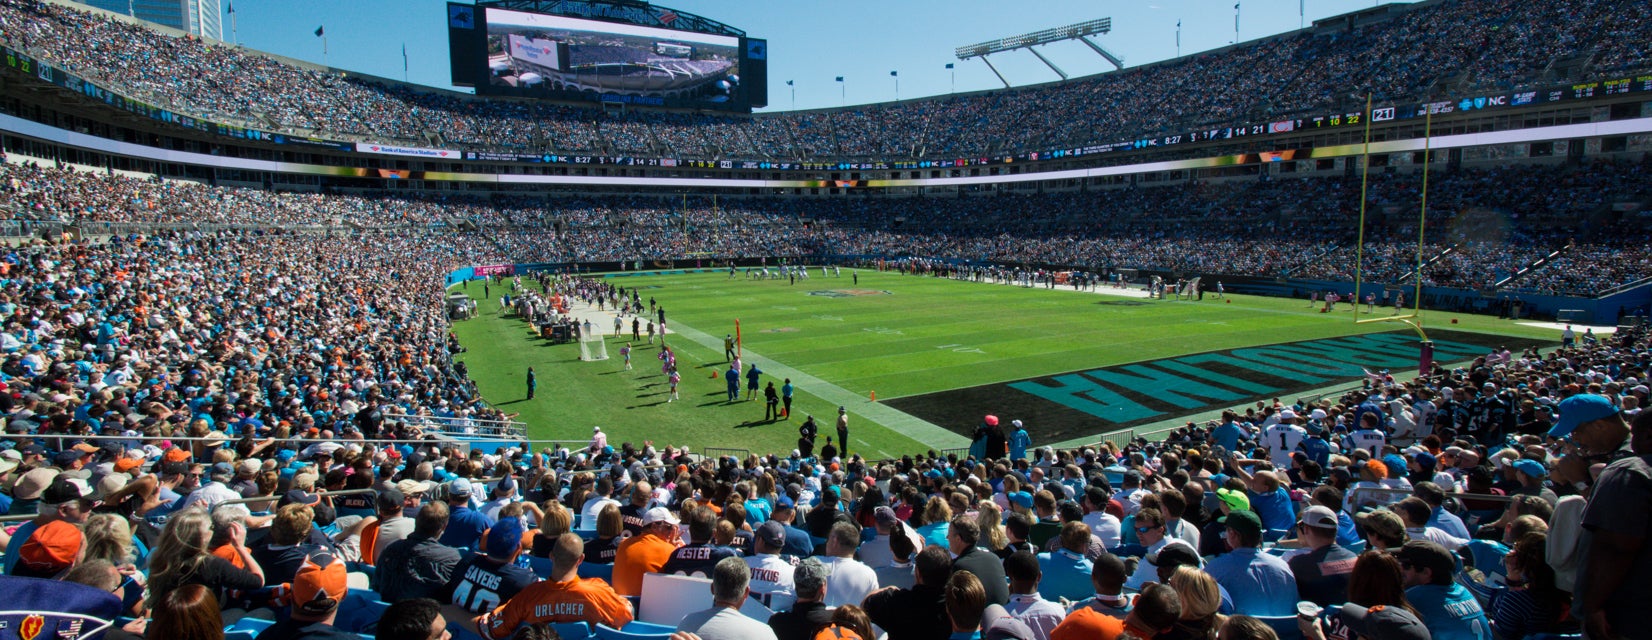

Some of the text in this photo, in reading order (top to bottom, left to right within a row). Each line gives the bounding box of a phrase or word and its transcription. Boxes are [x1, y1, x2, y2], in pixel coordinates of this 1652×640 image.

[1488, 96, 1506, 106] NC
[1347, 115, 1359, 124] 22
[1375, 110, 1390, 120] 21
[1316, 120, 1321, 128] 1
[1330, 118, 1340, 126] 10
[1235, 127, 1246, 136] 14
[1253, 125, 1264, 134] 21
[261, 133, 272, 141] NC
[1165, 136, 1181, 145] 8:27
[1148, 138, 1157, 146] NC
[1280, 432, 1288, 451] 1
[676, 547, 711, 559] HESTER
[464, 564, 503, 591] SAYERS
[750, 567, 780, 583] UTKUS
[535, 602, 585, 618] URLACHER
